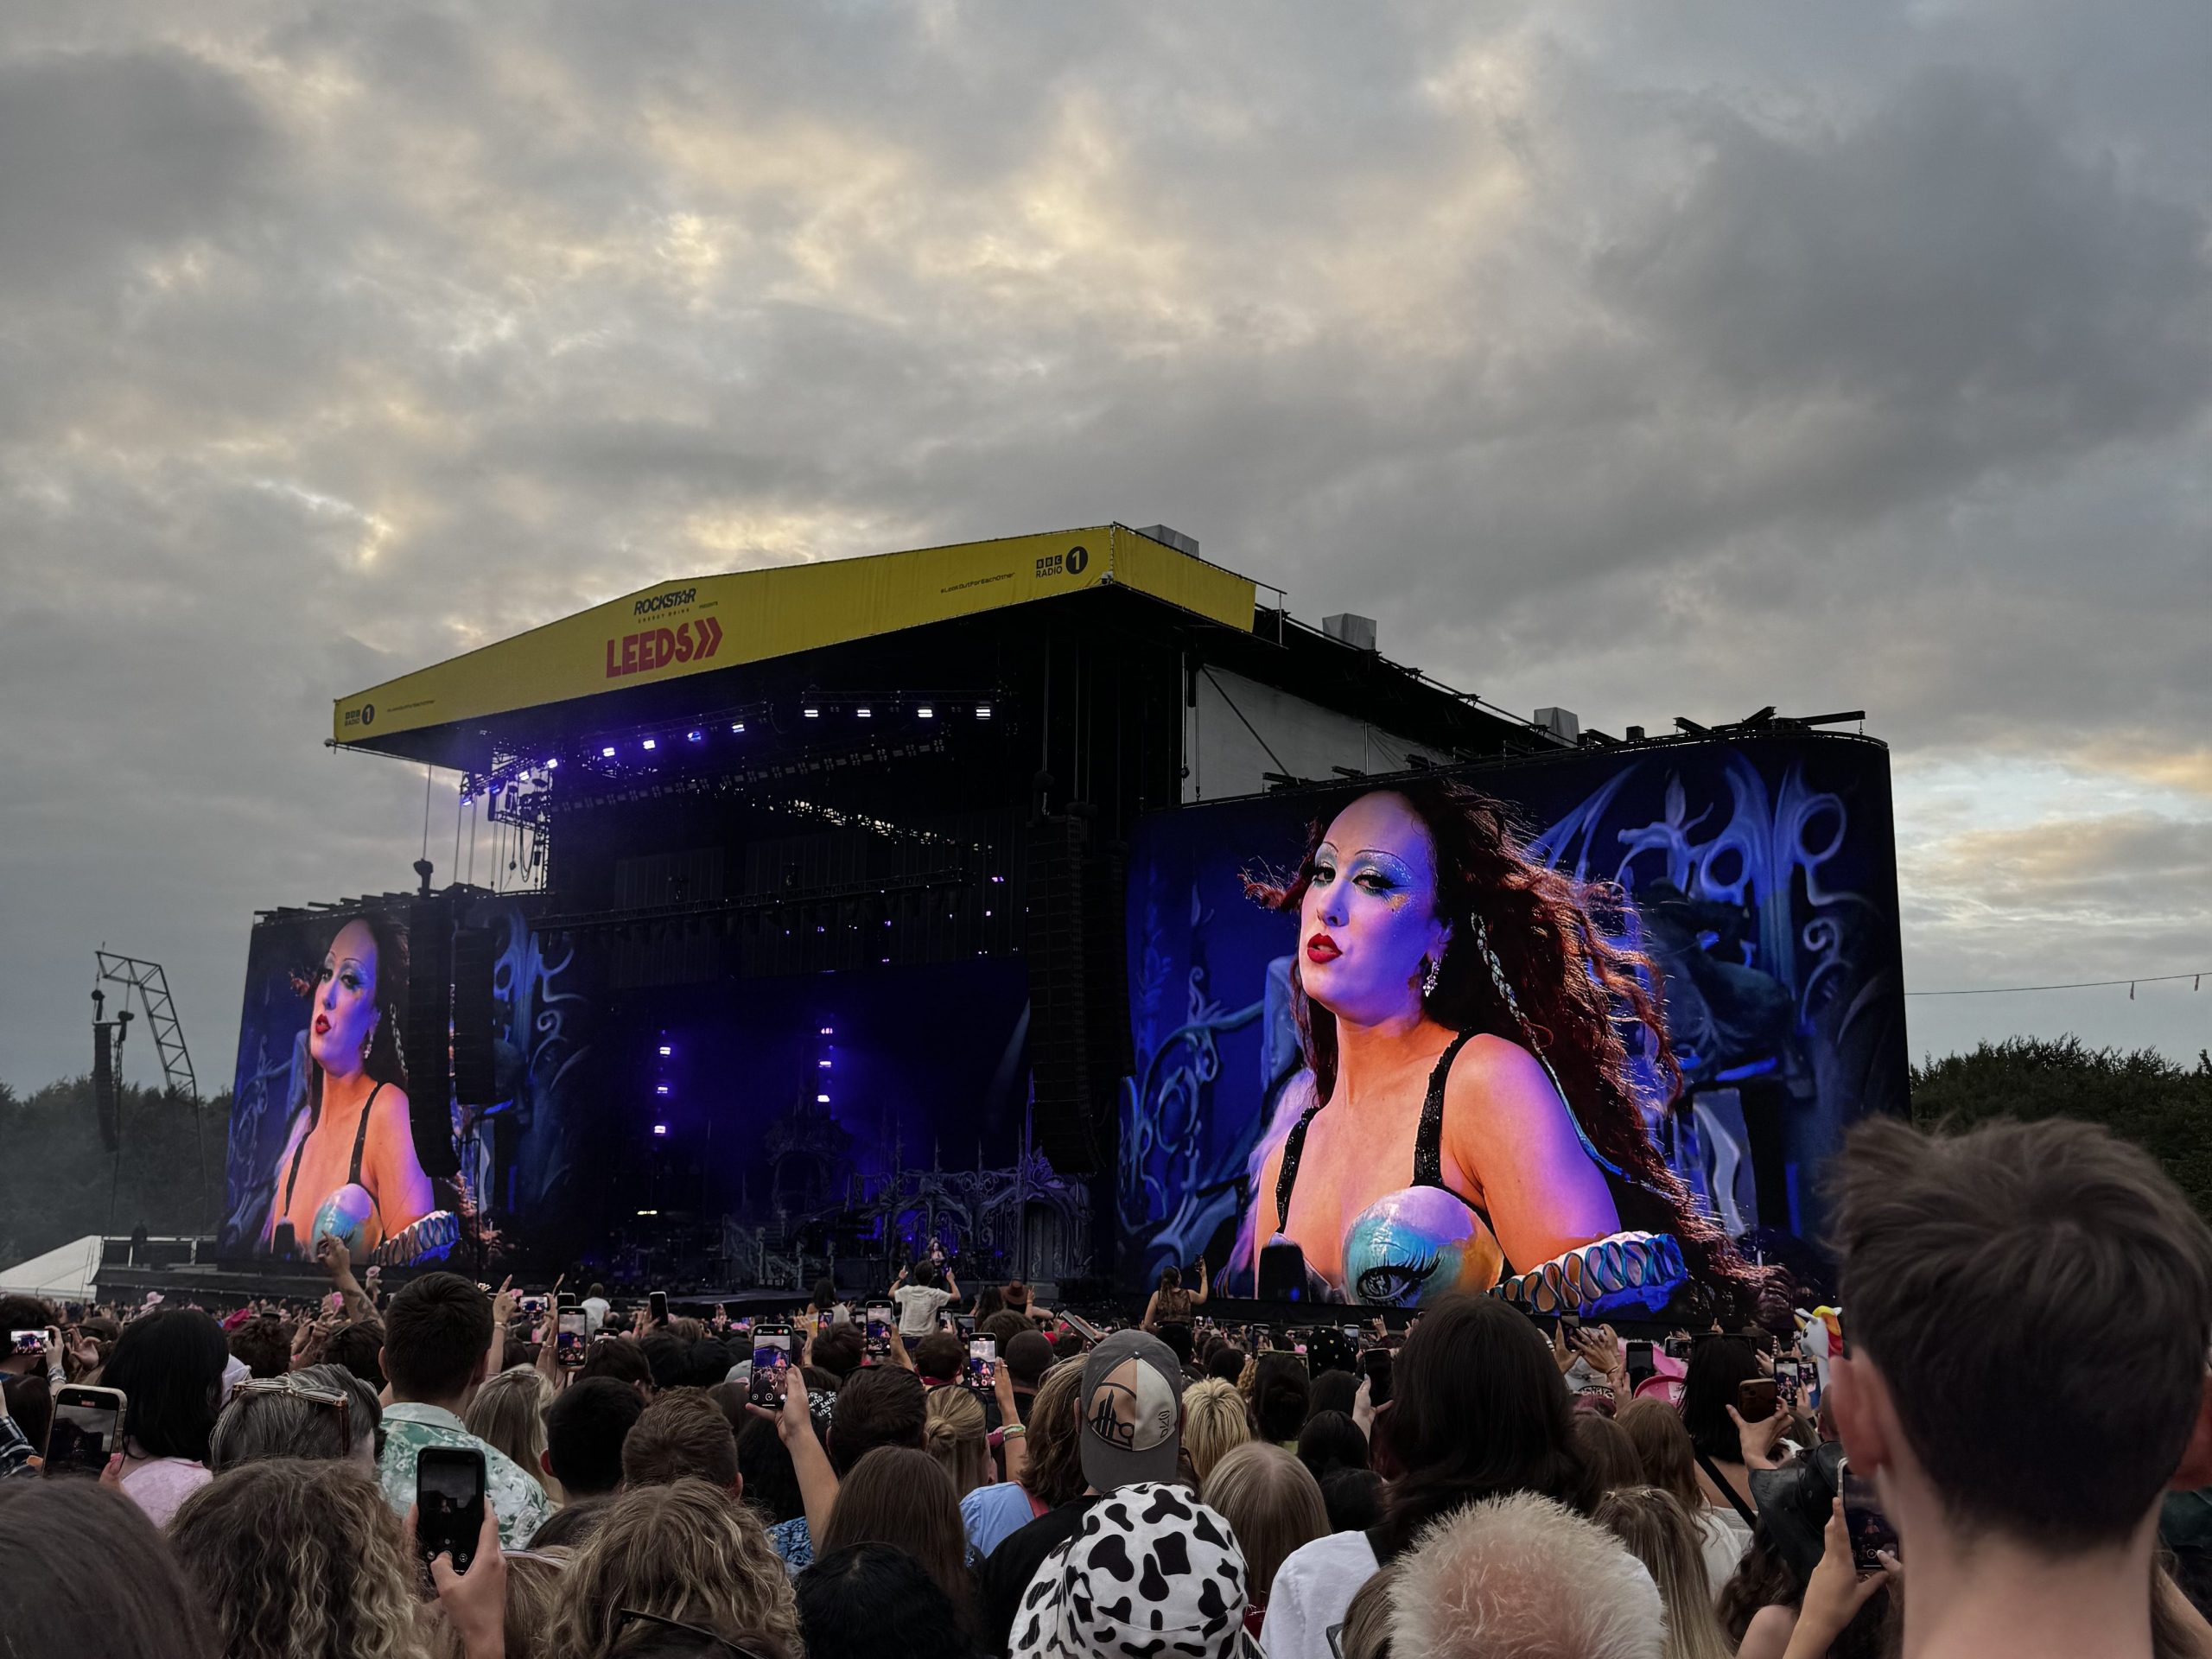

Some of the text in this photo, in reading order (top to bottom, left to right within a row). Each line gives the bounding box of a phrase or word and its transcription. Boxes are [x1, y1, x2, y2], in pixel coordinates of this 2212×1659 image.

[1036, 555, 1063, 569] BBC
[1036, 566, 1063, 578] RADIO
[633, 588, 697, 616] ROCKSTAR
[606, 622, 694, 678] LEEDS
